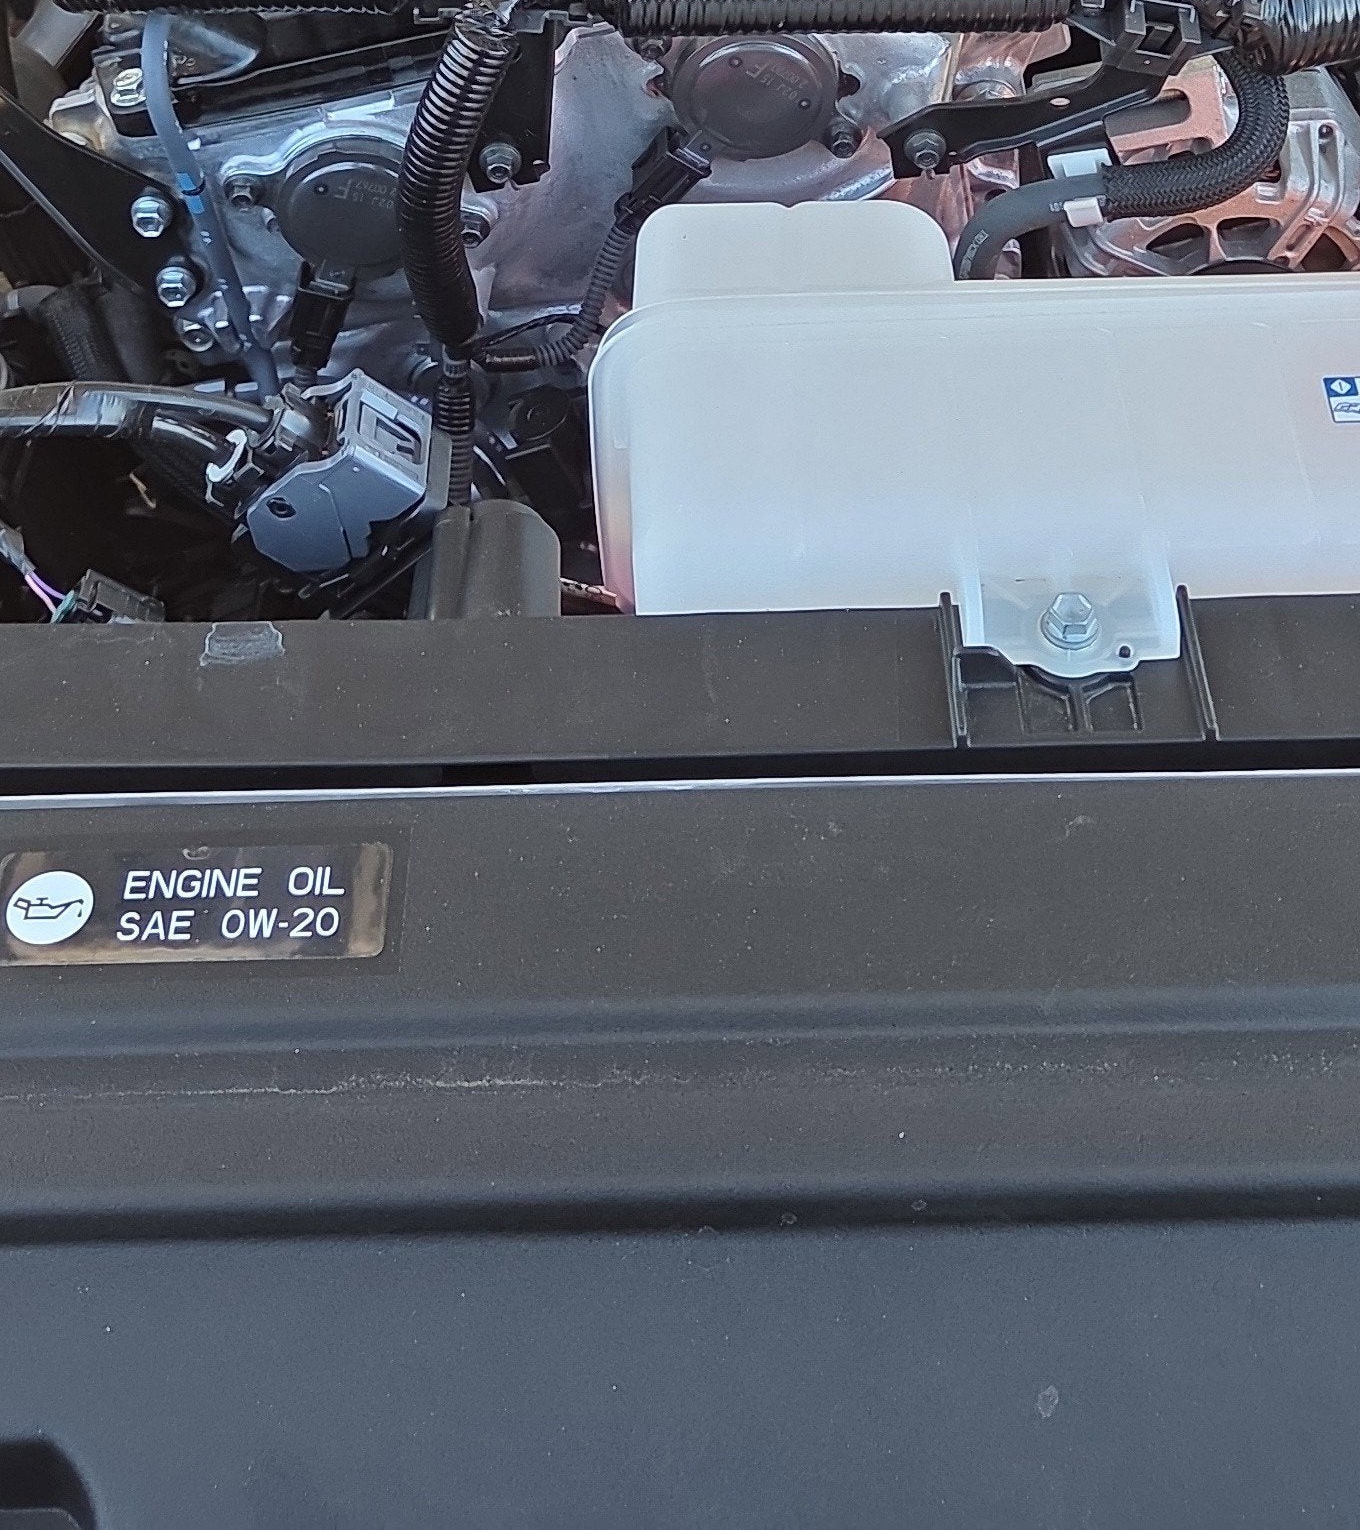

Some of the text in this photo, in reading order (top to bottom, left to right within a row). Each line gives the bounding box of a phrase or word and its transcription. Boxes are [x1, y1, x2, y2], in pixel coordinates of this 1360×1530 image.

[122, 865, 345, 900] ENGINE OIL
[116, 906, 340, 941] SAE 0W-20
